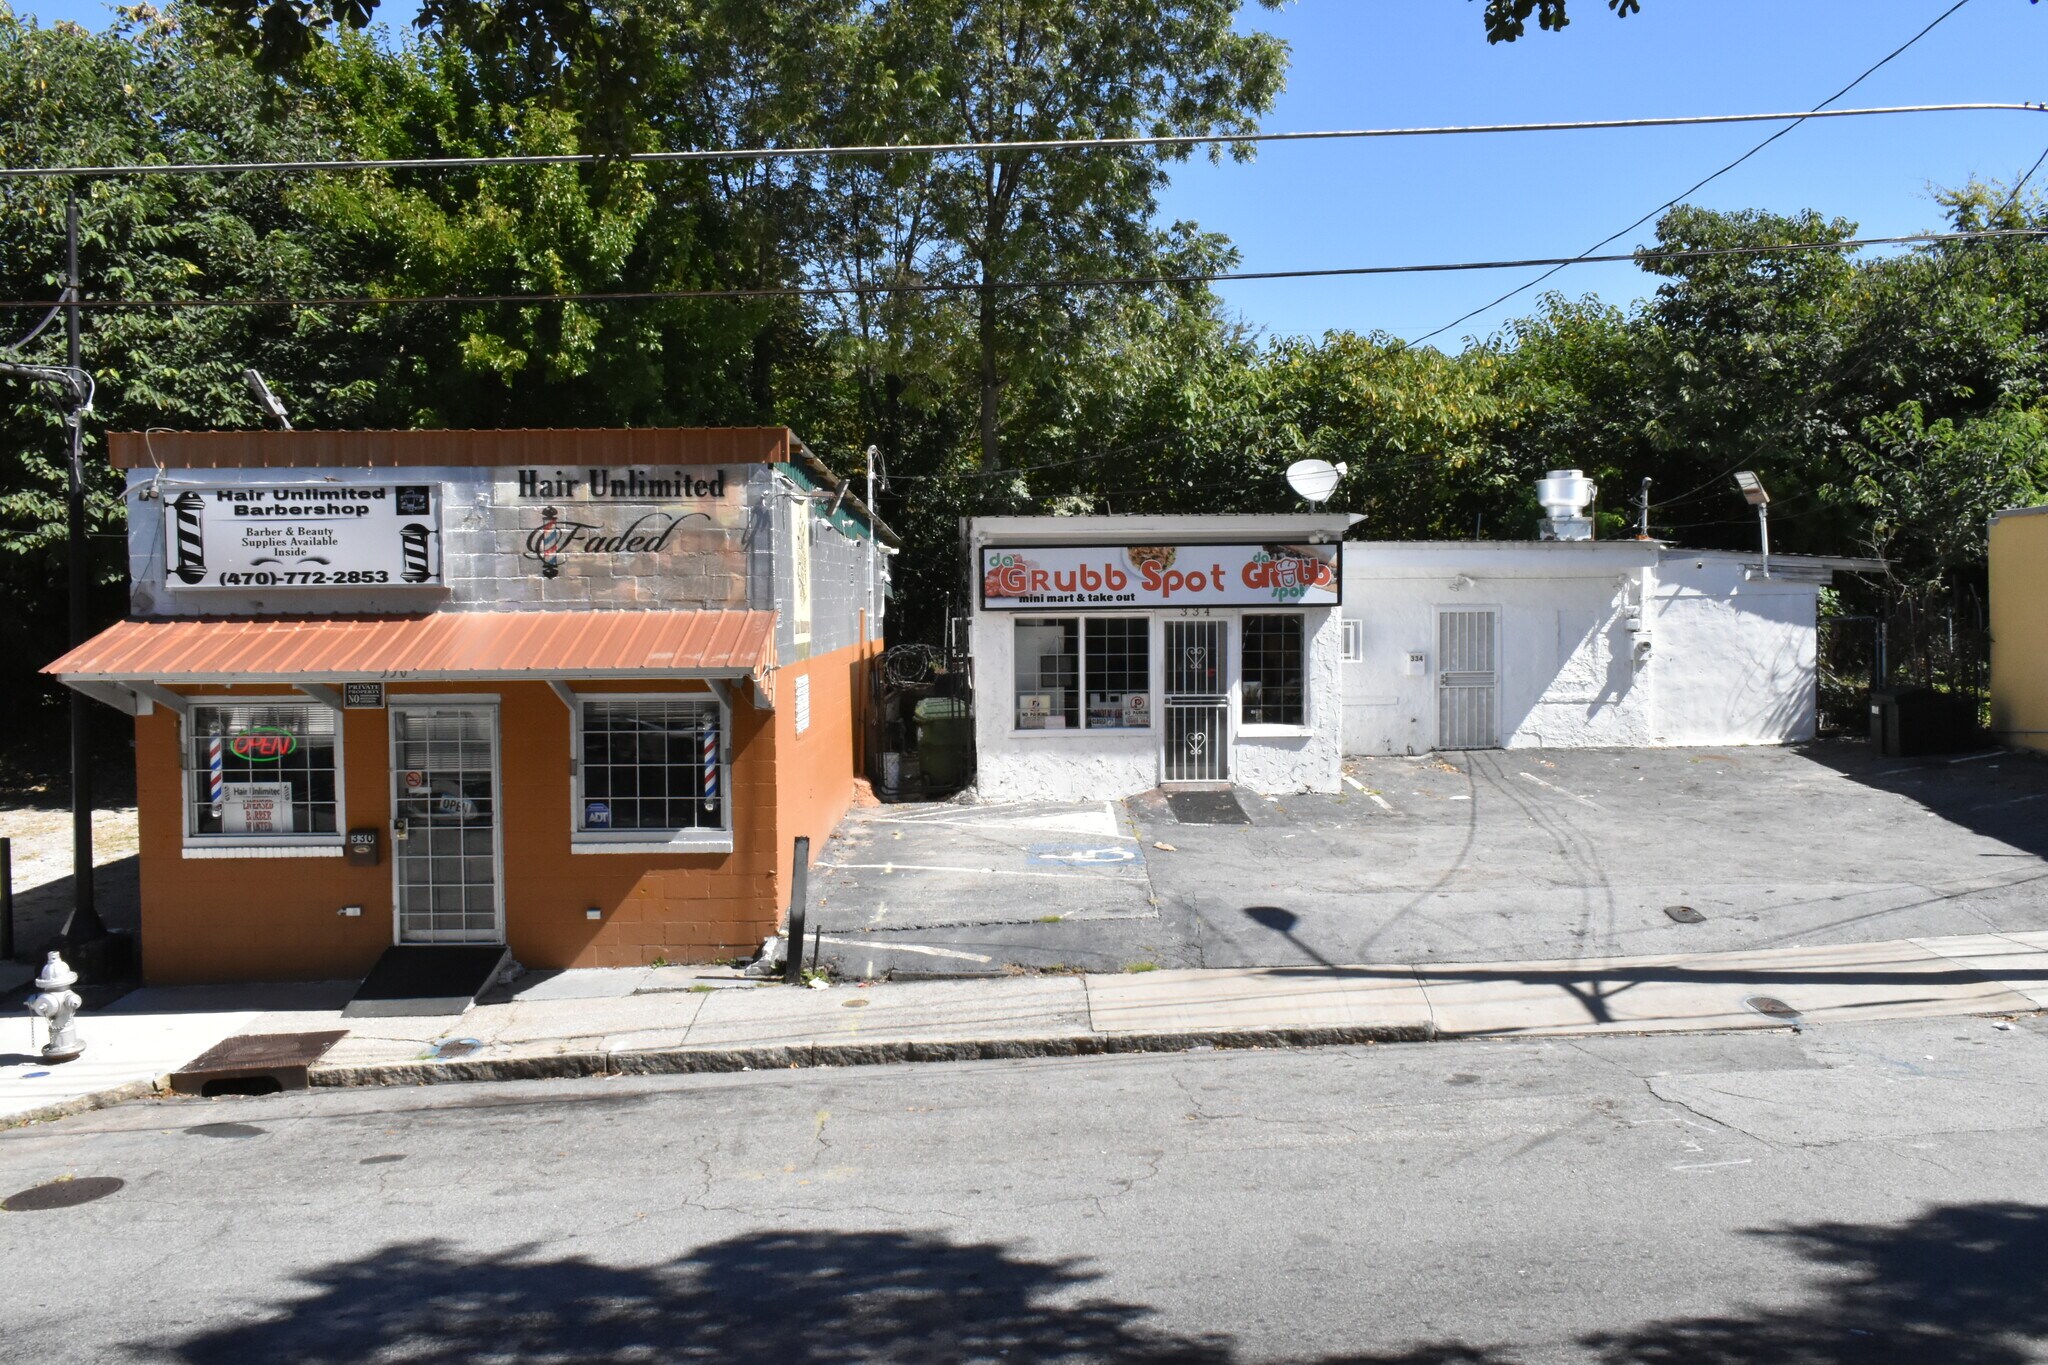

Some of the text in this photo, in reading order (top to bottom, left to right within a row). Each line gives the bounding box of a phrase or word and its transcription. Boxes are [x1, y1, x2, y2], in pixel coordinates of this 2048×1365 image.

[518, 469, 725, 498] Hair Unlimited
[217, 487, 386, 501] Hair Unlimited
[234, 503, 370, 517] Barbershop
[246, 526, 334, 538] Barber & Beauty
[242, 536, 338, 548] Supplies Available
[523, 512, 712, 566] Faded
[274, 547, 307, 557] Inside
[1252, 551, 1270, 563] da
[989, 552, 1014, 567] da
[219, 571, 389, 586] (470)-772-2853
[1141, 559, 1226, 598] Spot
[1019, 592, 1136, 603] mini mart & take out
[1180, 607, 1211, 617] 334
[348, 694, 360, 703] NO
[233, 734, 292, 755] OPEN
[233, 787, 248, 796] Hair
[442, 798, 472, 816] OPEN
[589, 811, 608, 823] ADT
[351, 834, 375, 843] 330
